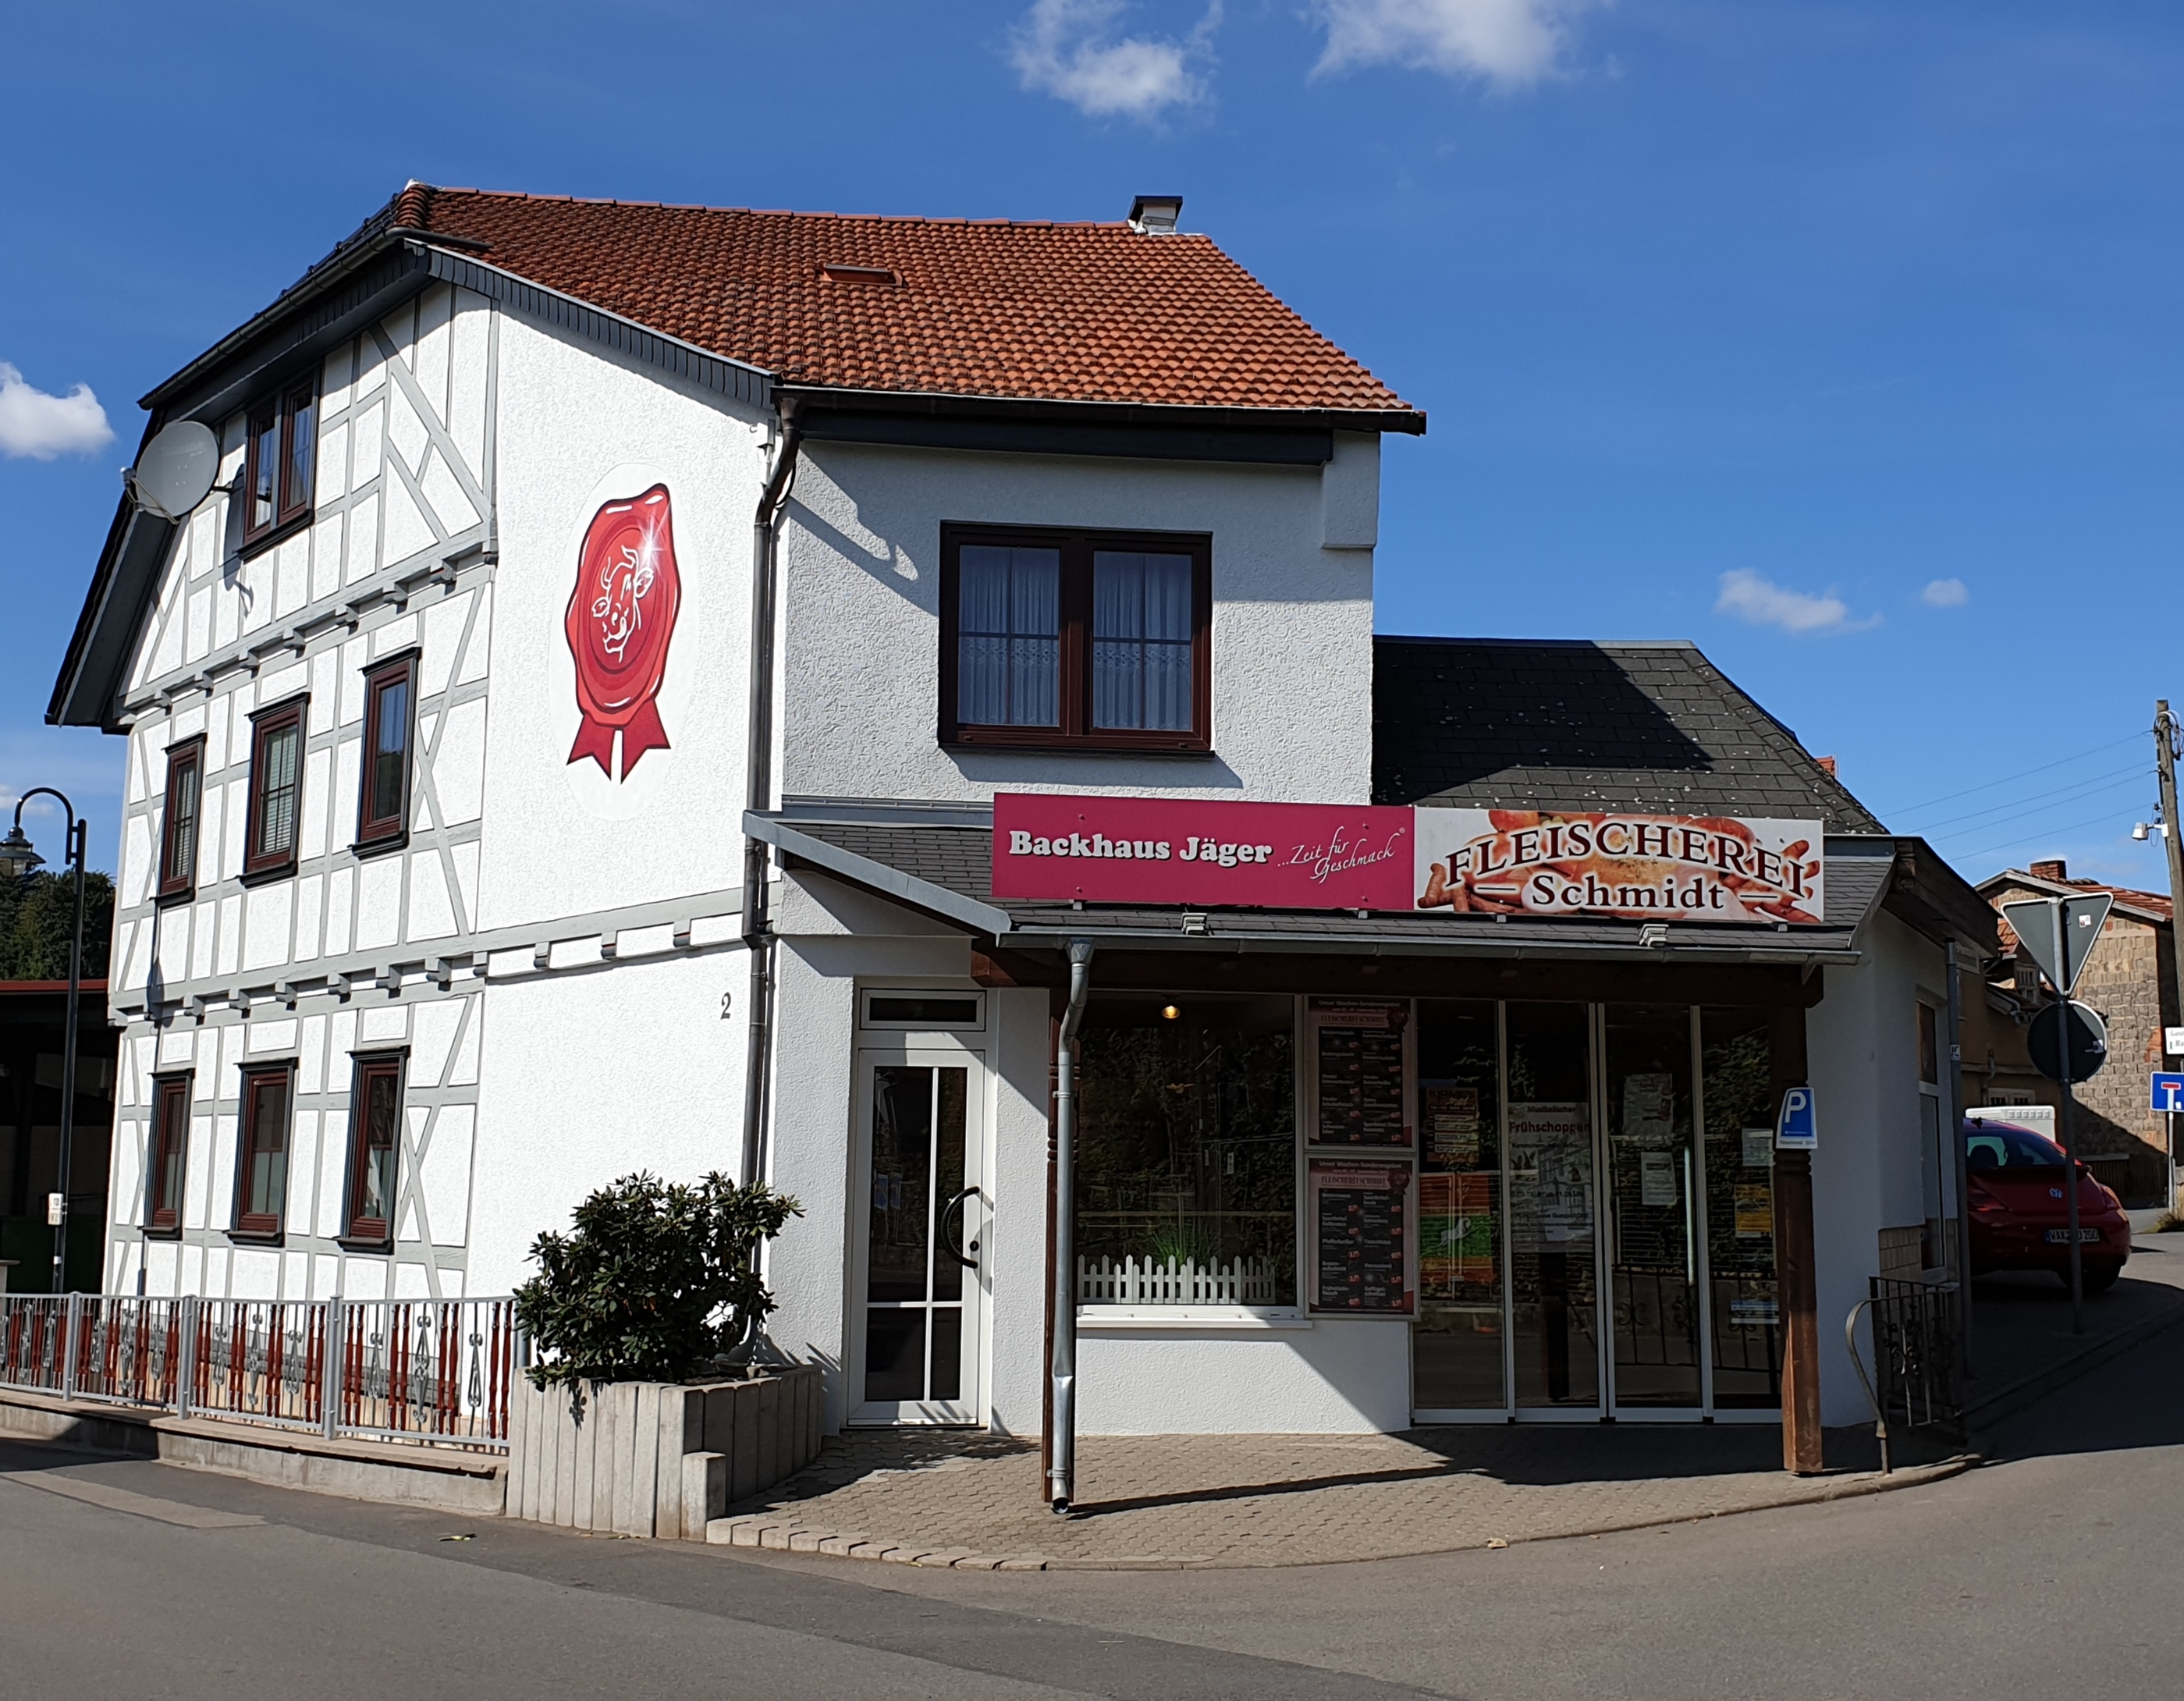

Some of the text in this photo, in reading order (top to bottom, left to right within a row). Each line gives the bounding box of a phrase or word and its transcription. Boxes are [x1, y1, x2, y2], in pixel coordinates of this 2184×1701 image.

[1009, 830, 1273, 868] Backhaus Jäger
[1309, 833, 1401, 884] Geschmack
[1328, 826, 1350, 861] für
[1445, 822, 1809, 899] FLEISCHEREI
[1531, 875, 1724, 911] Schmidt
[720, 992, 732, 1020] 2
[1784, 1091, 1807, 1124] P
[1509, 1120, 1590, 1134] Frühschoppen
